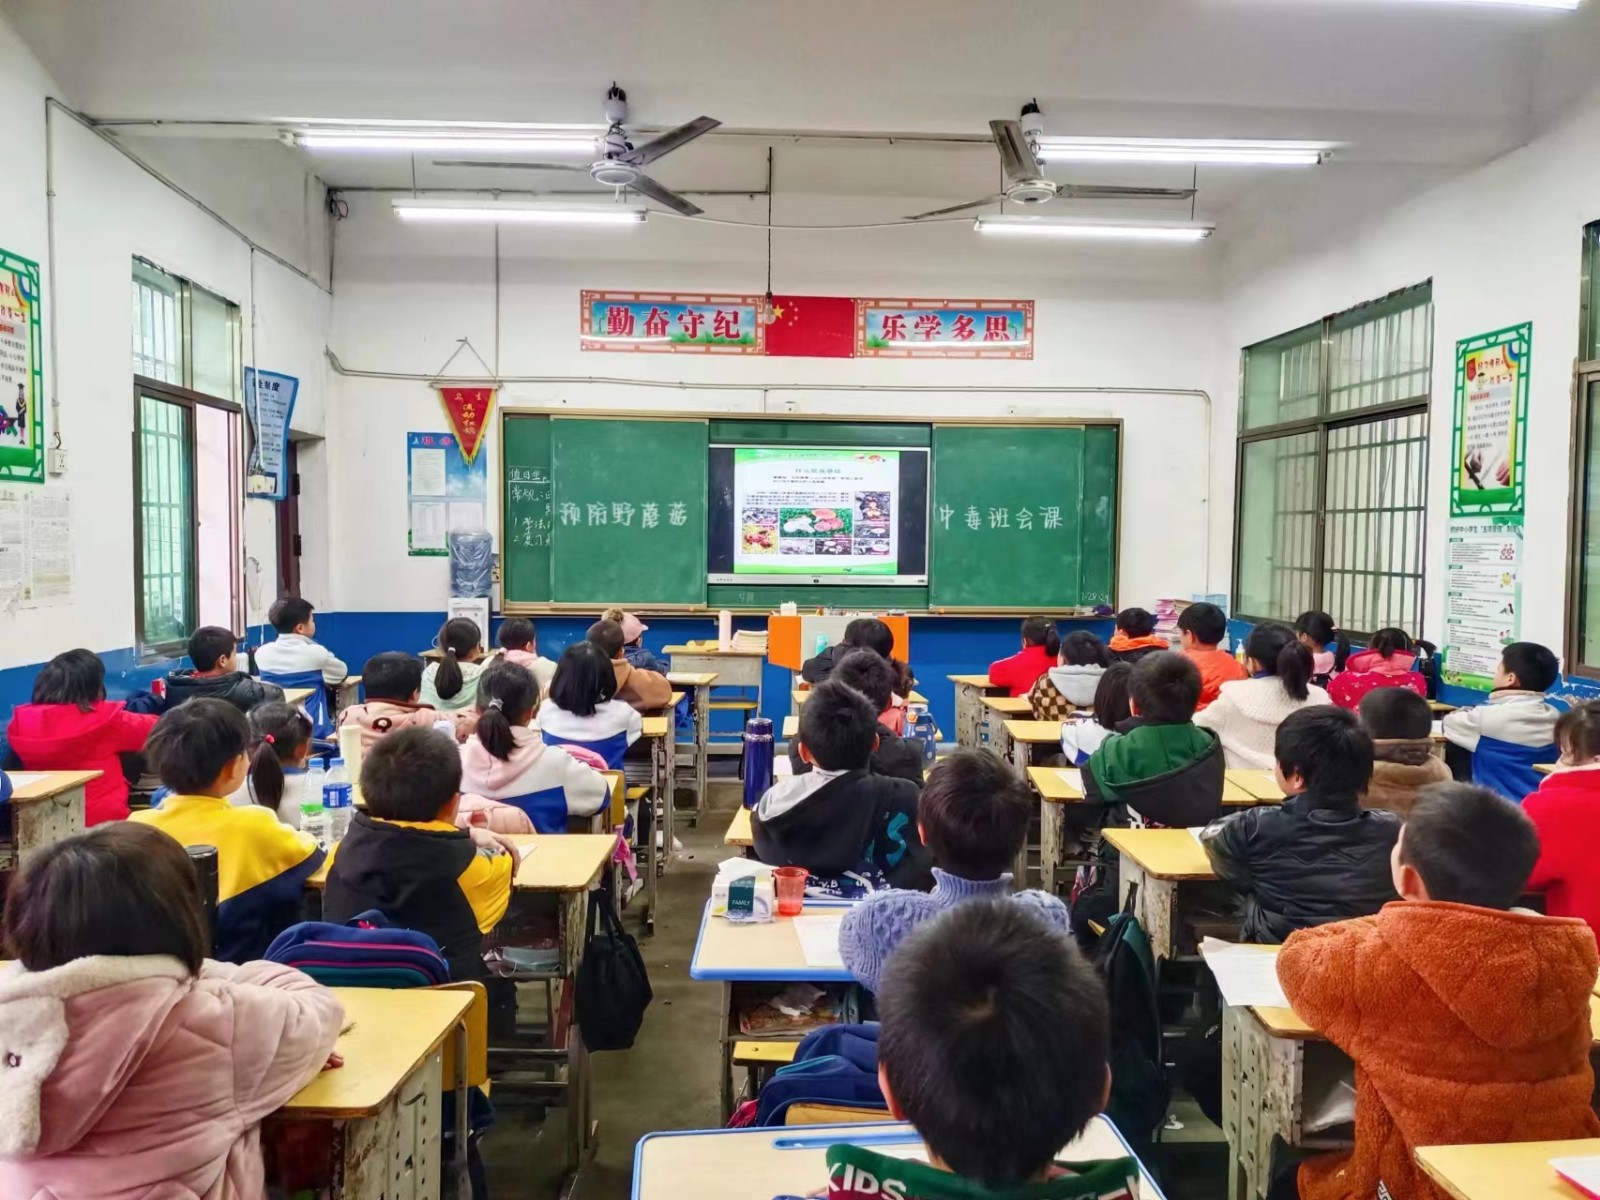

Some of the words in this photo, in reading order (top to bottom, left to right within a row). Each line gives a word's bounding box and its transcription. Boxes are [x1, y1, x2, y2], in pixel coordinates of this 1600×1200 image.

[605, 305, 742, 340] 勤奋守纪
[880, 313, 1012, 342] 乐学多思
[558, 500, 689, 530] 预防野蘑菇
[938, 503, 1064, 532] 中毒班会课
[826, 1162, 908, 1200] KIDS
